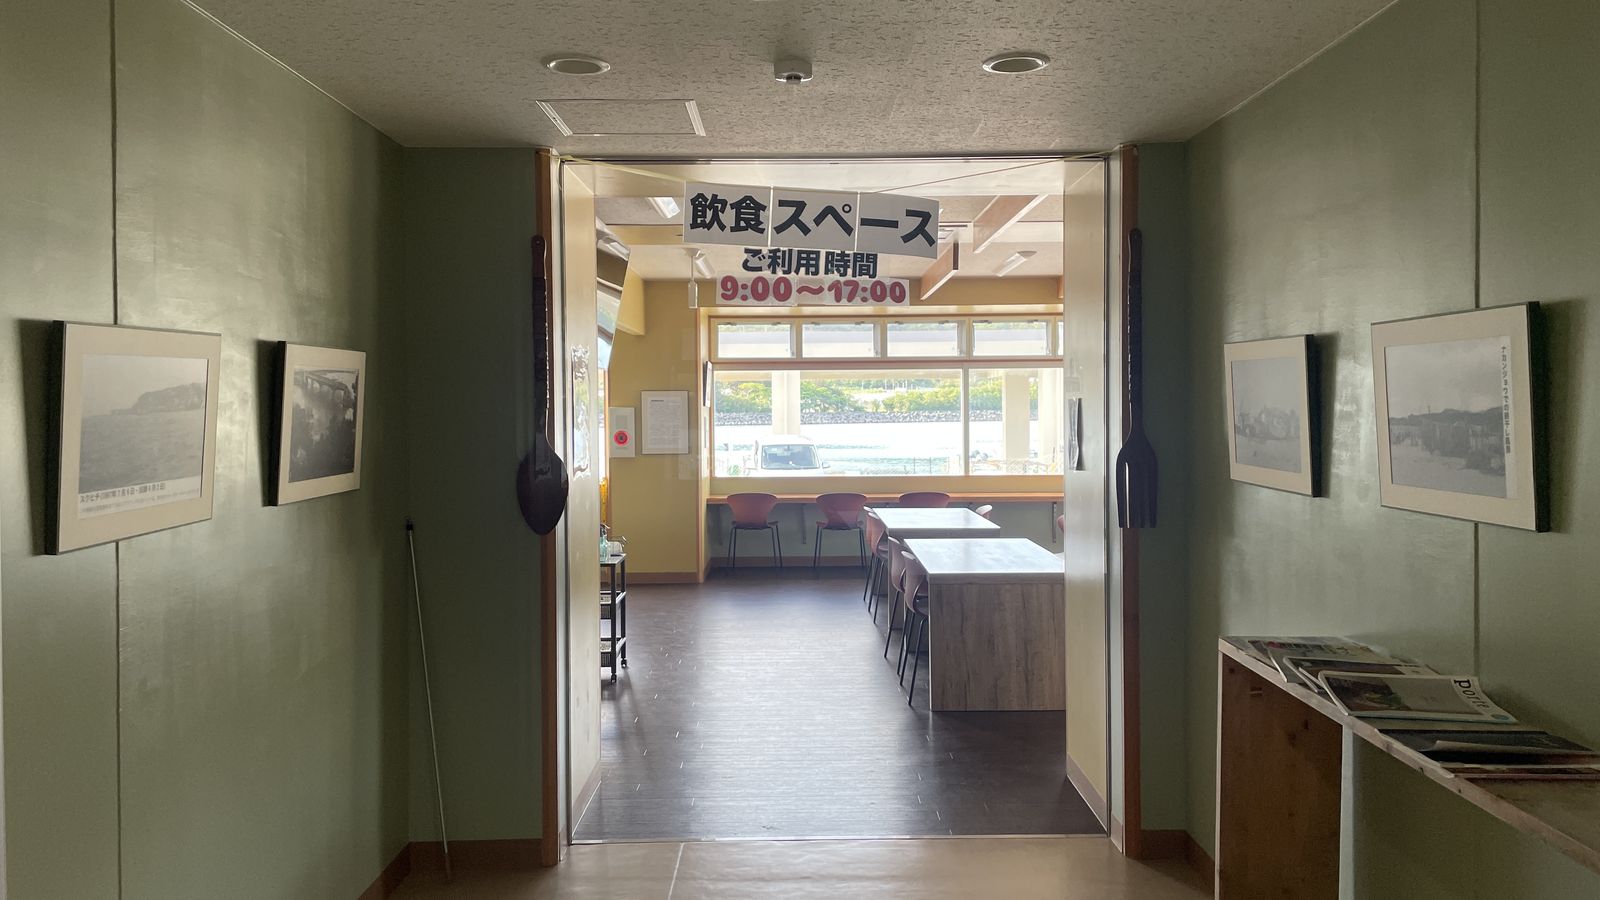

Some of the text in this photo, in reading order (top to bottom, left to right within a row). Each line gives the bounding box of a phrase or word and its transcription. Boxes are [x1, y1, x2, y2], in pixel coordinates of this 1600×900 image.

[689, 192, 936, 247] 飲食スペース
[742, 248, 878, 279] ご利用時間
